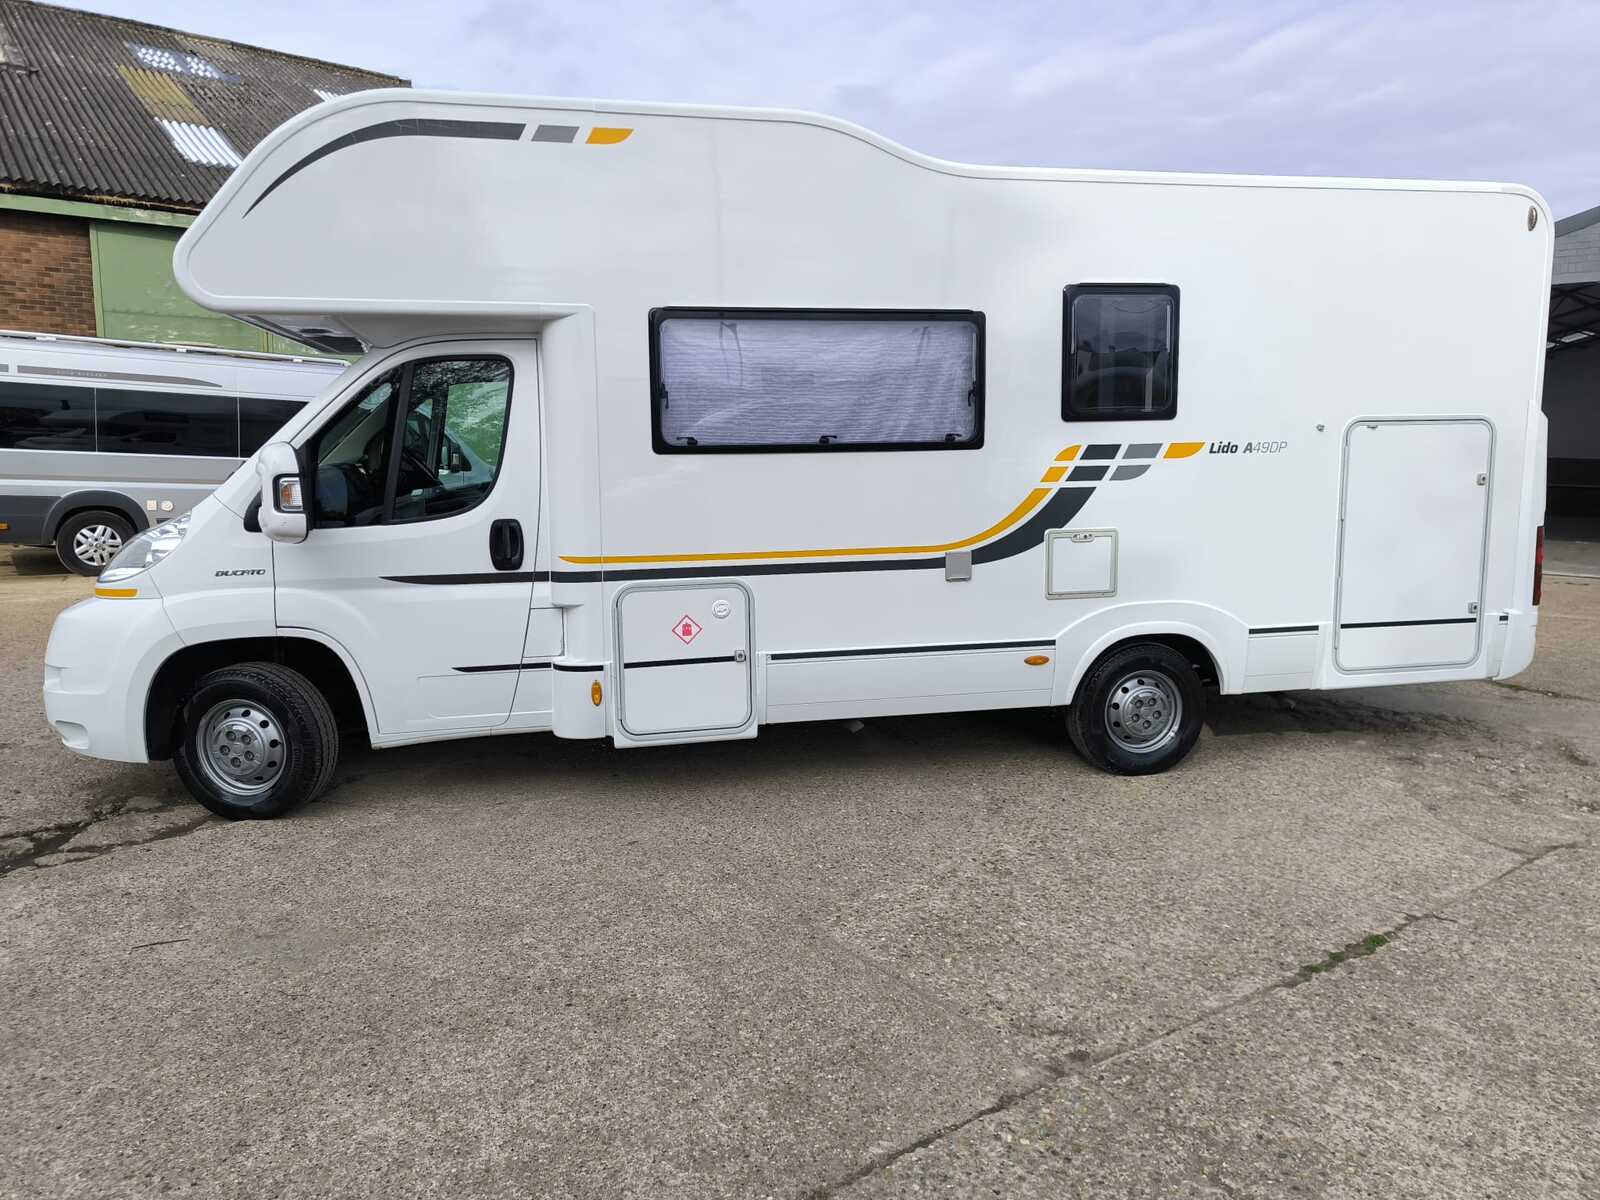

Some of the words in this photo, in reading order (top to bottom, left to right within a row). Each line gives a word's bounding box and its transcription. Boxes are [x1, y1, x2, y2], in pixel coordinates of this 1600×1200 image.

[1209, 441, 1239, 454] Lido
[1243, 441, 1288, 454] A49DP
[215, 569, 266, 577] DUCATO
